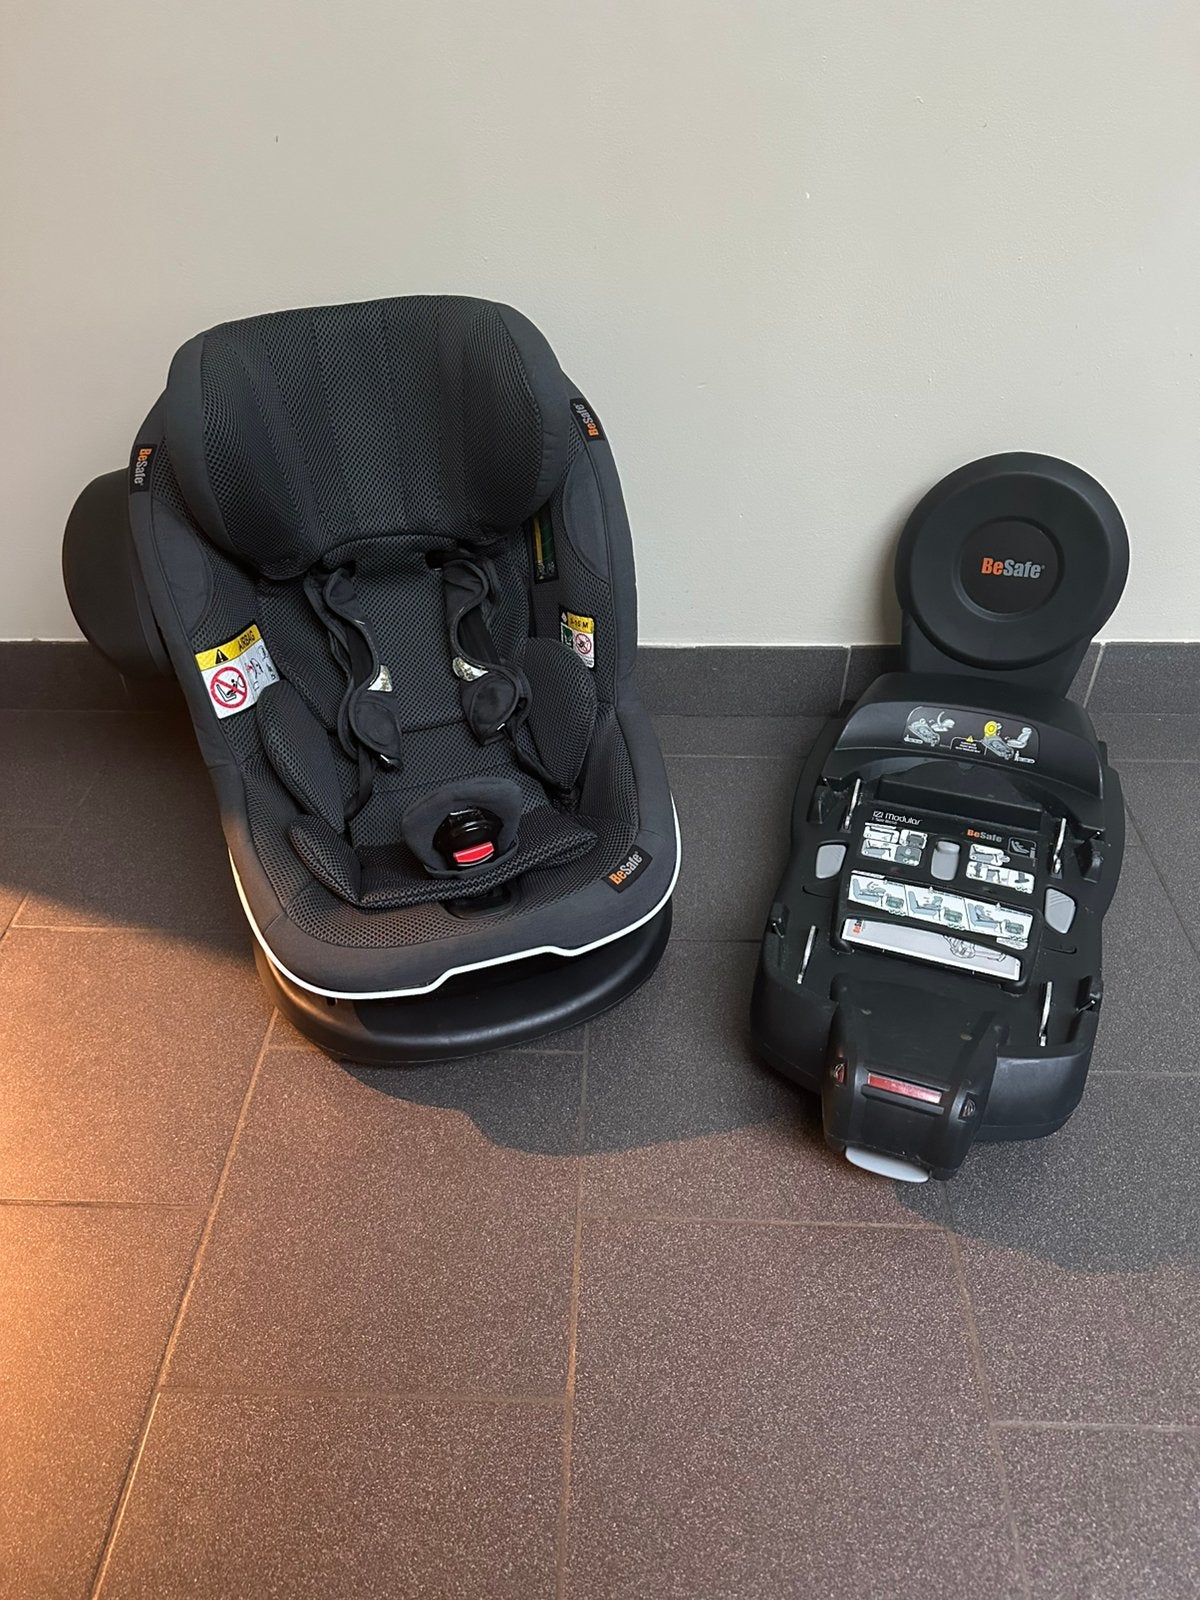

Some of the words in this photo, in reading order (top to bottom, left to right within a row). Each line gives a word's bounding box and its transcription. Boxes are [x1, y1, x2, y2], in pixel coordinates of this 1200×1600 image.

[573, 403, 600, 437] BeSafe
[134, 448, 153, 485] BeSafe
[981, 557, 1042, 579] BeSafe
[885, 812, 921, 826] Modular
[966, 828, 1003, 843] BeSafe
[608, 851, 643, 885] BeSafe
